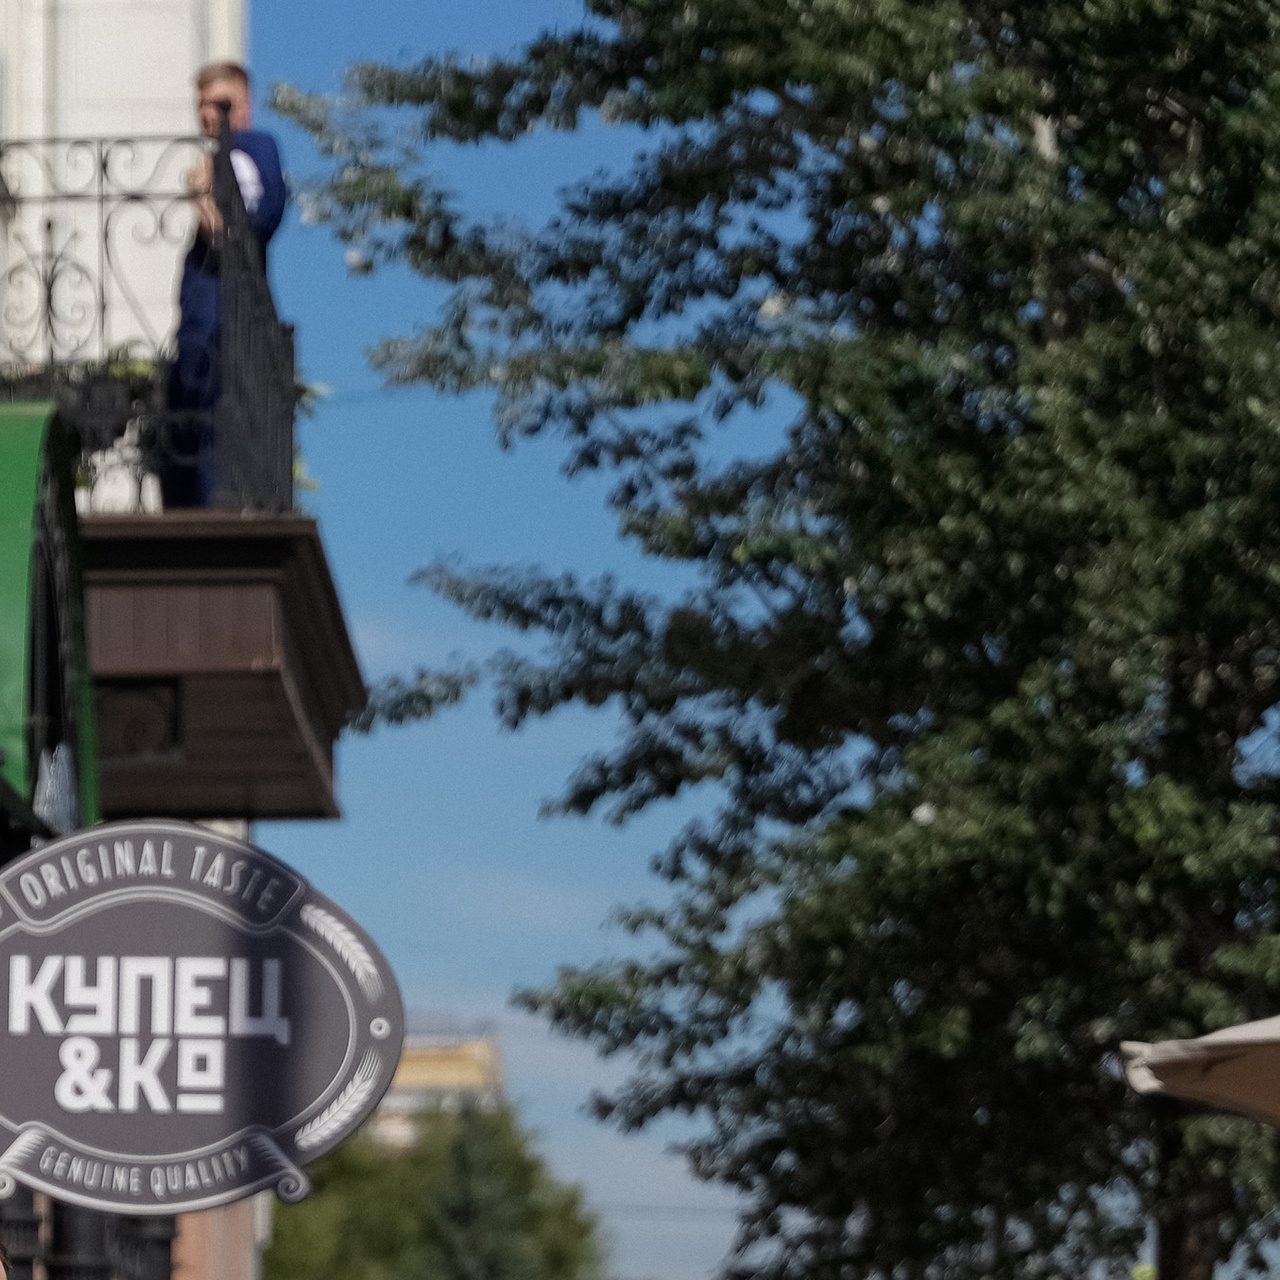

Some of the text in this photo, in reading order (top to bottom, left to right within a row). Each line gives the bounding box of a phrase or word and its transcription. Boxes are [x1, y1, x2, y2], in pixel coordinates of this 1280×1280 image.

[20, 839, 279, 911] ORIGINAL TASTE
[8, 955, 291, 1045] КУПЕЦ
[39, 1146, 248, 1200] GENUINE QUALITY
